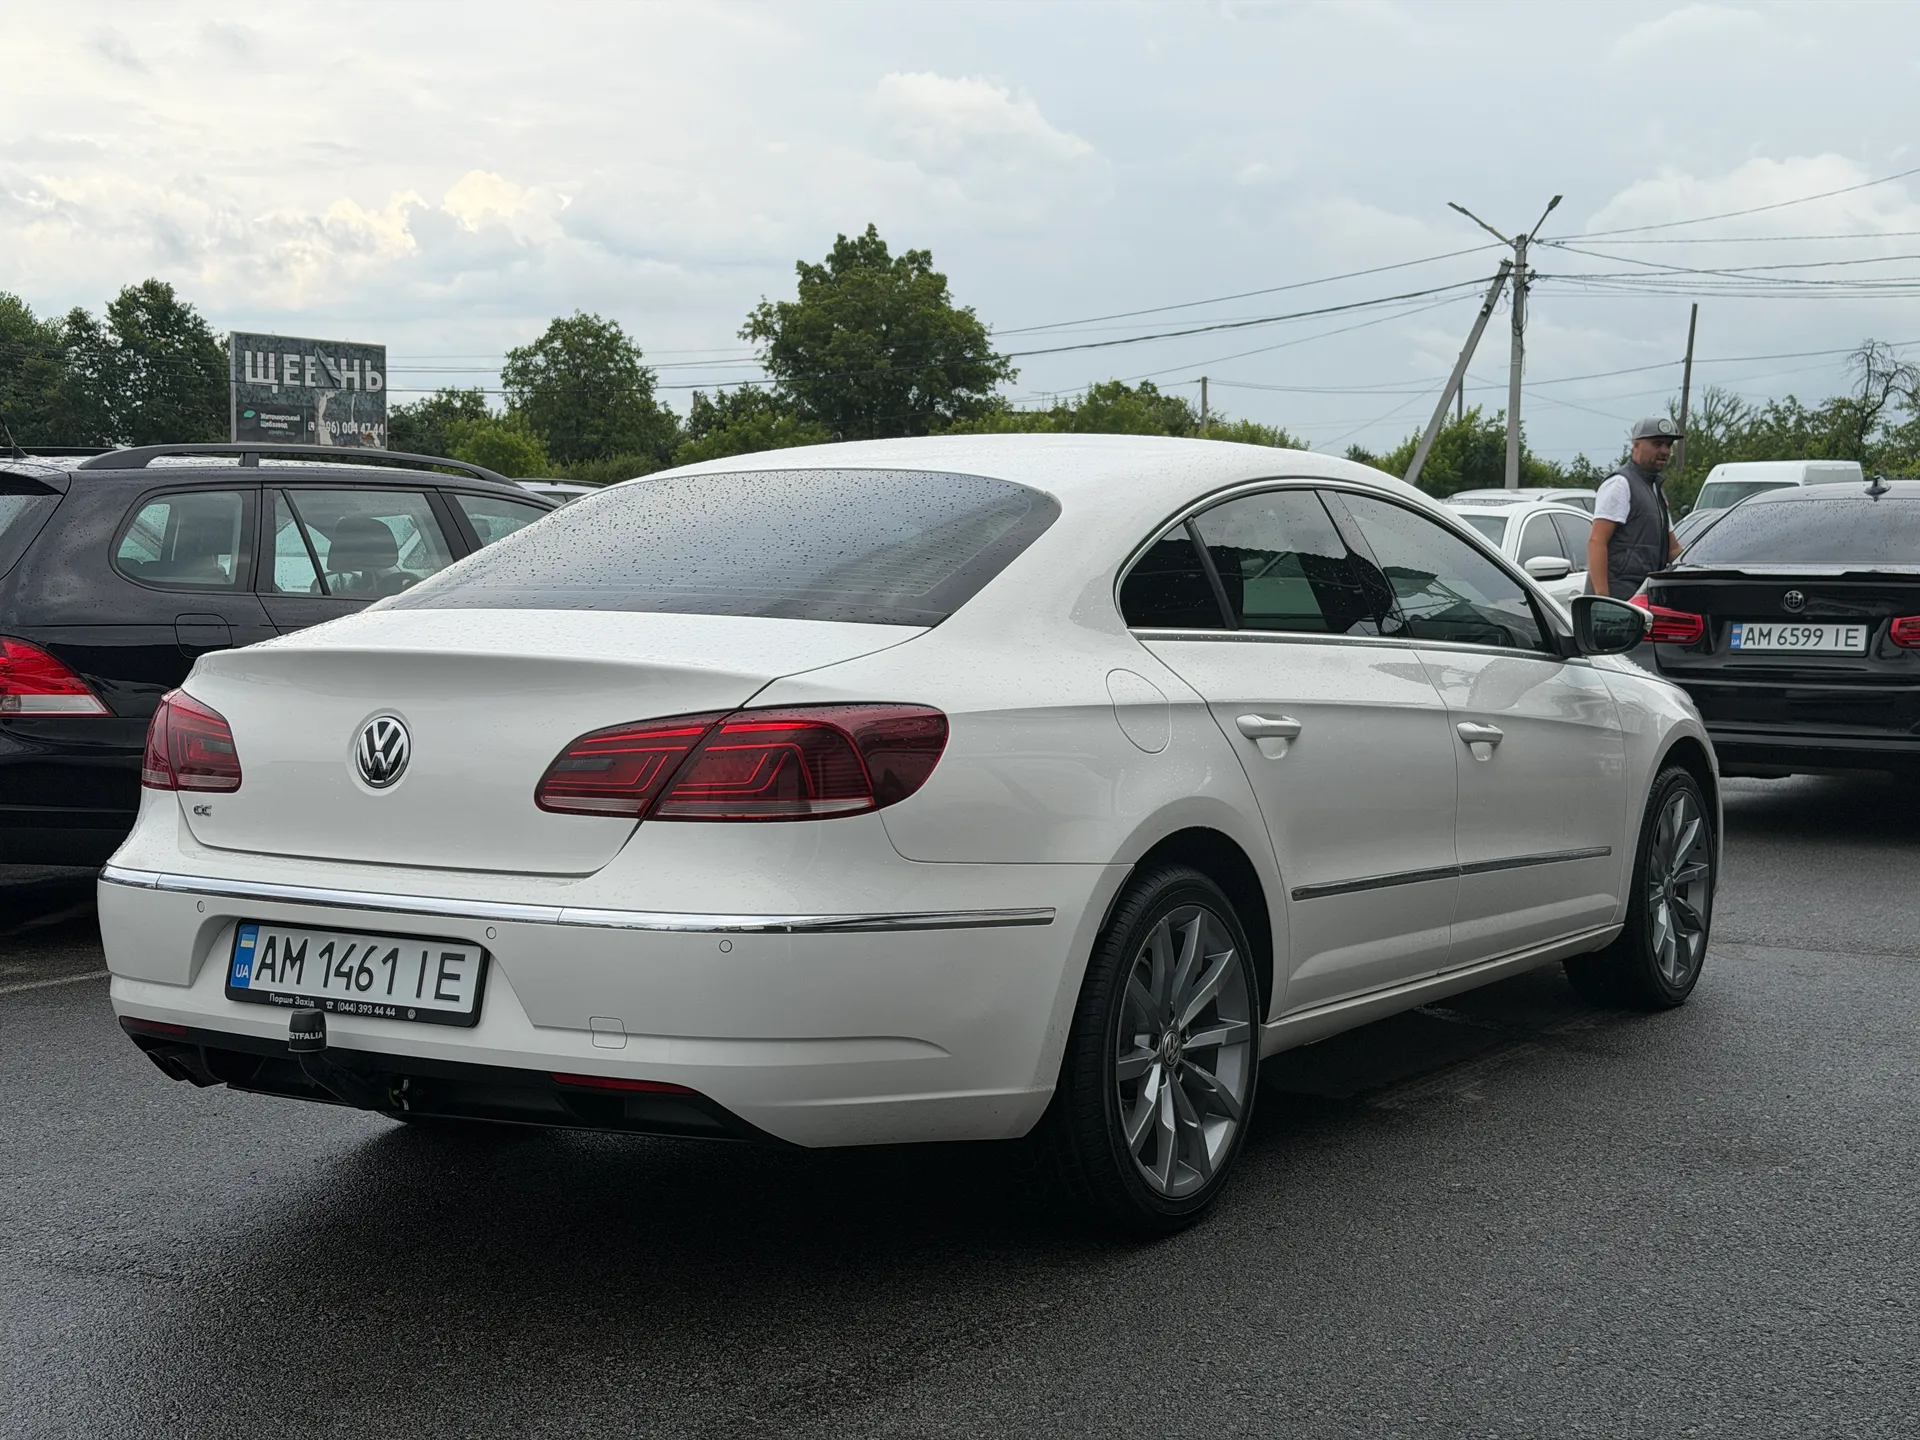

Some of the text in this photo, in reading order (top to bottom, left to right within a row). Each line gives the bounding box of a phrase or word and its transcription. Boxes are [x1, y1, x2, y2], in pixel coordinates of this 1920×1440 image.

[245, 350, 383, 394] ЩЕБНЬ
[342, 421, 358, 434] 004
[1743, 627, 1859, 647] AM 6599 IE
[193, 804, 212, 817] CC
[235, 963, 249, 979] UA
[254, 935, 466, 1002] AM 1461 IE
[269, 993, 315, 1008] Порше Захід
[337, 1001, 357, 1013] (044)
[358, 1003, 373, 1014] 393
[374, 1005, 384, 1015] 44
[385, 1006, 396, 1017] 44
